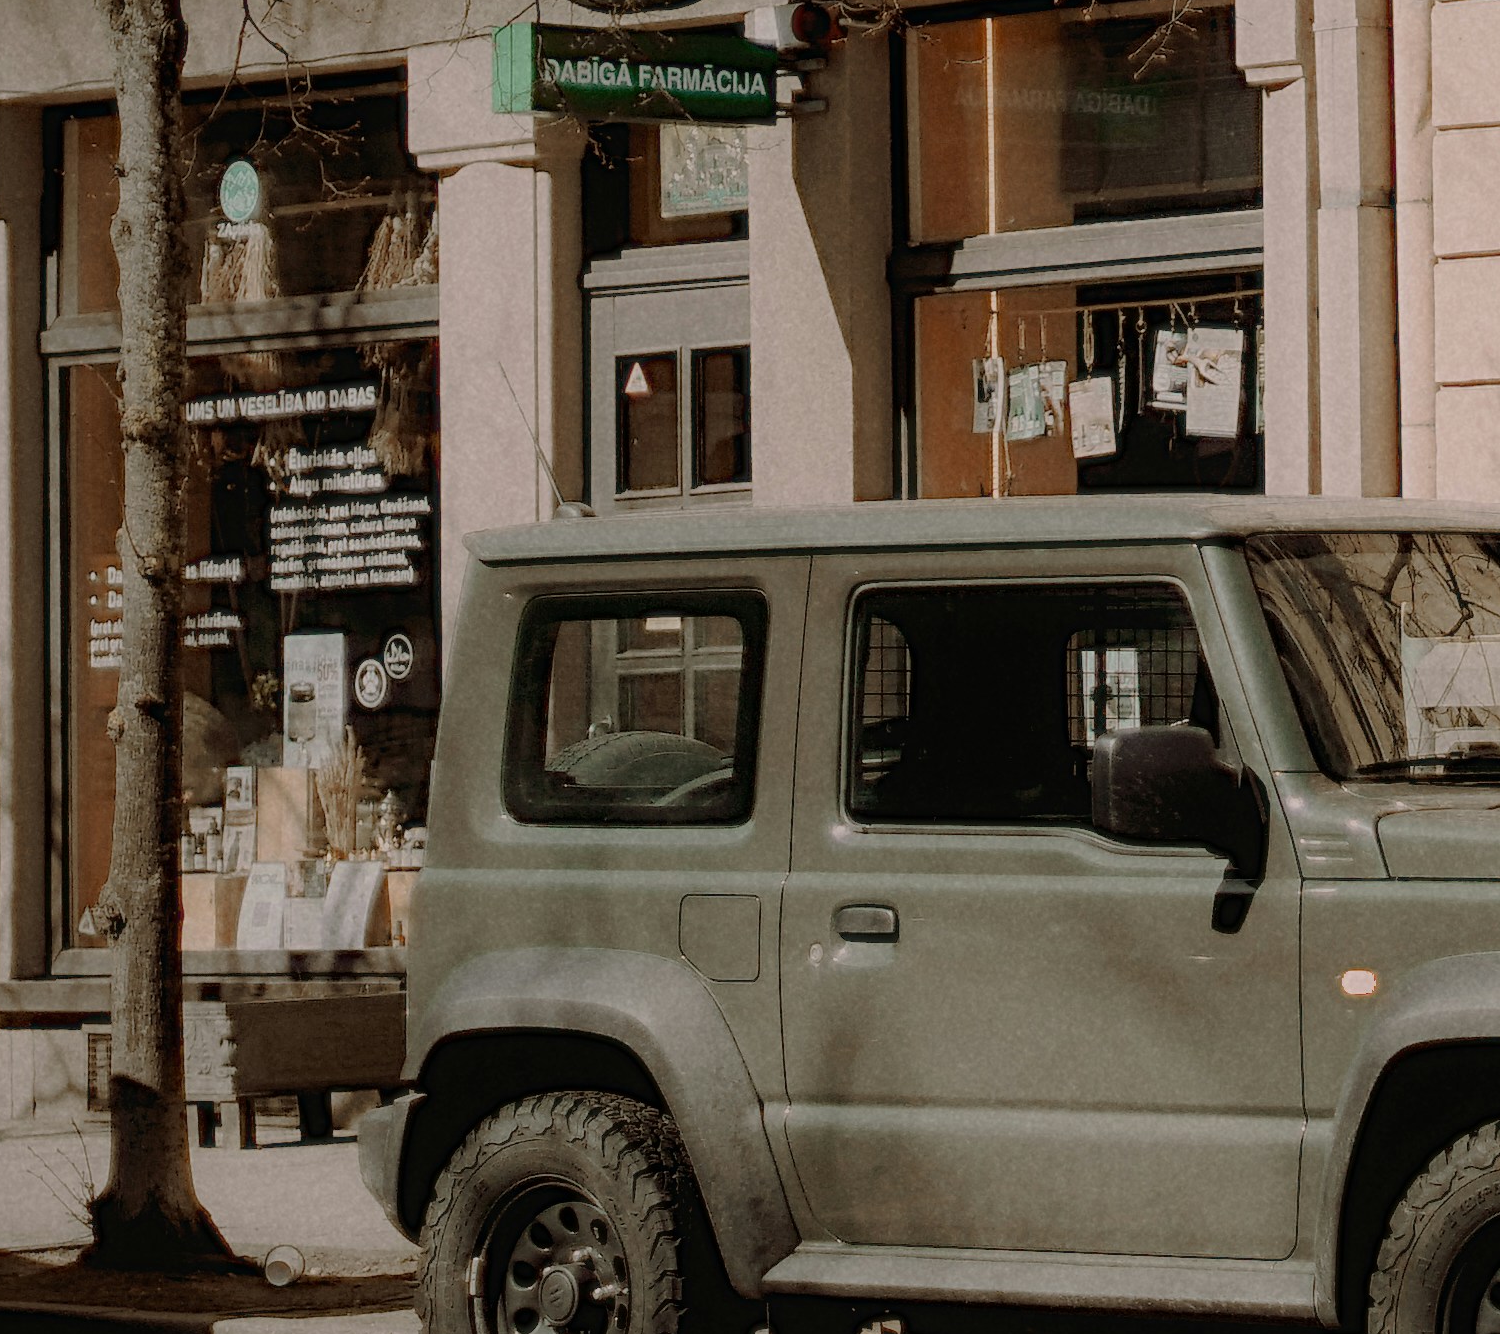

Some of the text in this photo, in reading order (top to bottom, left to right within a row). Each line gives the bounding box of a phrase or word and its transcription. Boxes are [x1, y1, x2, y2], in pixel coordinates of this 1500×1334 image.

[545, 56, 767, 96] DABĪGĀ FARMĀCIJA
[216, 398, 236, 419] UN
[239, 389, 304, 417] VESELĪBA
[306, 390, 326, 411] NO
[329, 385, 376, 409] DABAS
[288, 476, 320, 497] Augu
